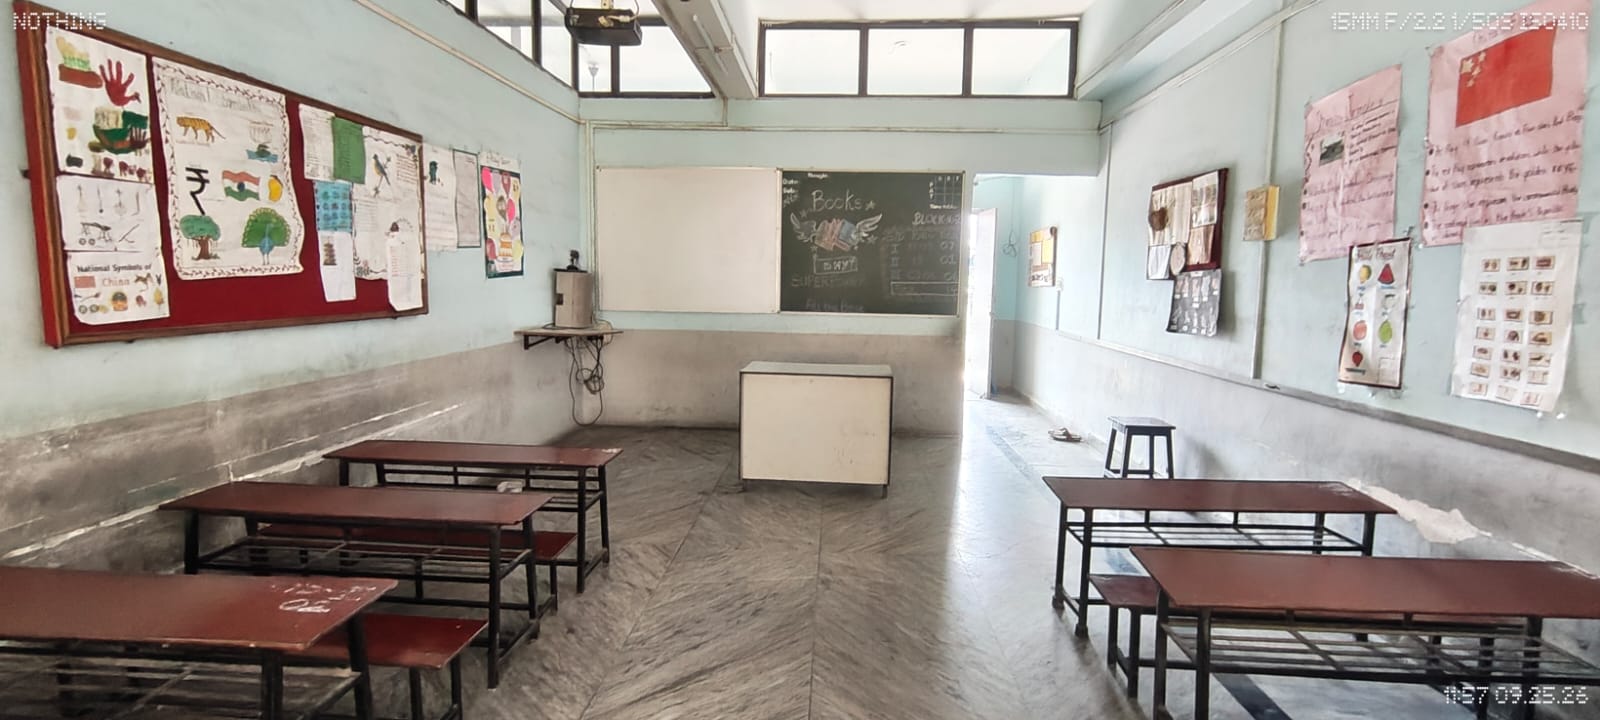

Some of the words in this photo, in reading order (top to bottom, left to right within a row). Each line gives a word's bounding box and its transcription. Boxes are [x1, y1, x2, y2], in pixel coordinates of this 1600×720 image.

[811, 188, 863, 212] Books
[77, 264, 110, 273] National
[112, 263, 143, 273] Symbols
[102, 277, 131, 287] China
